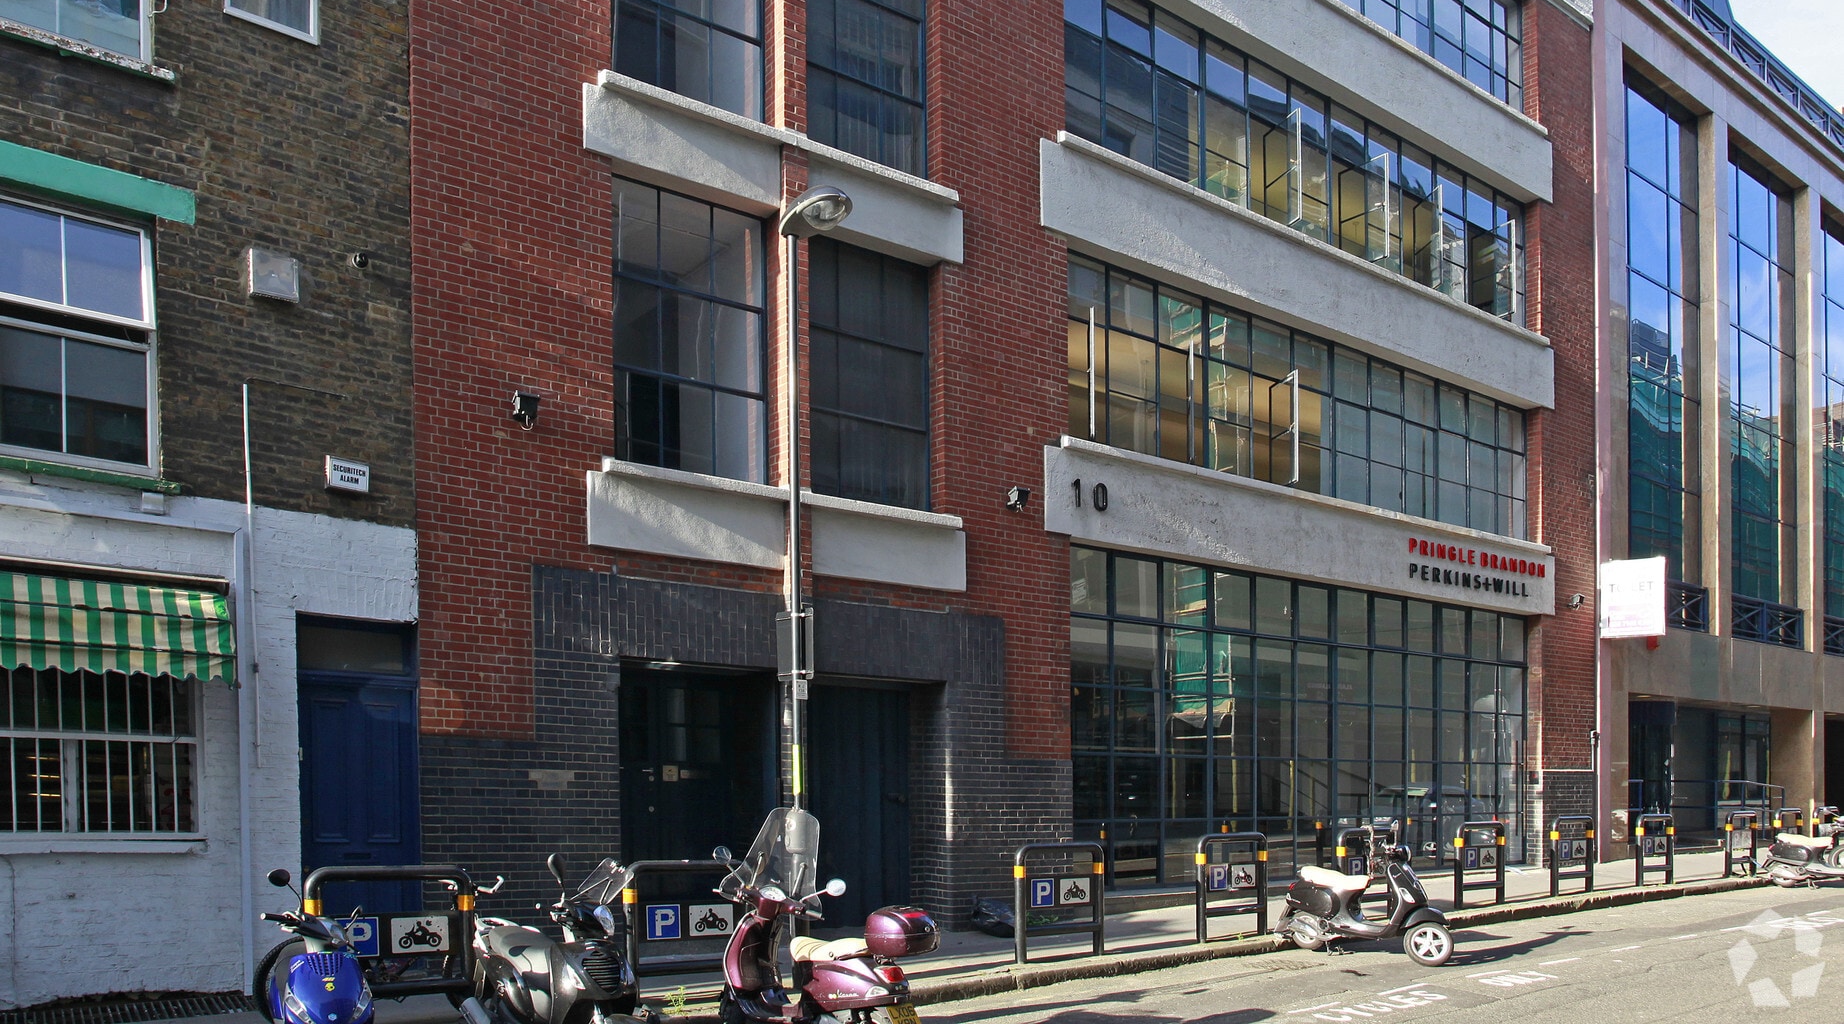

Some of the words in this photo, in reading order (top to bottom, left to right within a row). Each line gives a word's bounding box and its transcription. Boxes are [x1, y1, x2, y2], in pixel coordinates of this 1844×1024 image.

[333, 463, 366, 477] SECURITECH
[340, 474, 359, 484] ALARM
[1071, 478, 1108, 511] 10
[1408, 537, 1476, 565] PRINGLE
[1480, 551, 1546, 578] BRANDON
[1561, 841, 1569, 858] P
[1645, 838, 1652, 853] P
[1352, 860, 1361, 876] P
[1467, 849, 1475, 867] P
[1213, 867, 1225, 888] P
[1036, 881, 1051, 905] P
[655, 908, 676, 936] P
[346, 922, 372, 954] P
[1312, 990, 1449, 1023] CYCLES
[1478, 970, 1559, 988] ONLY
